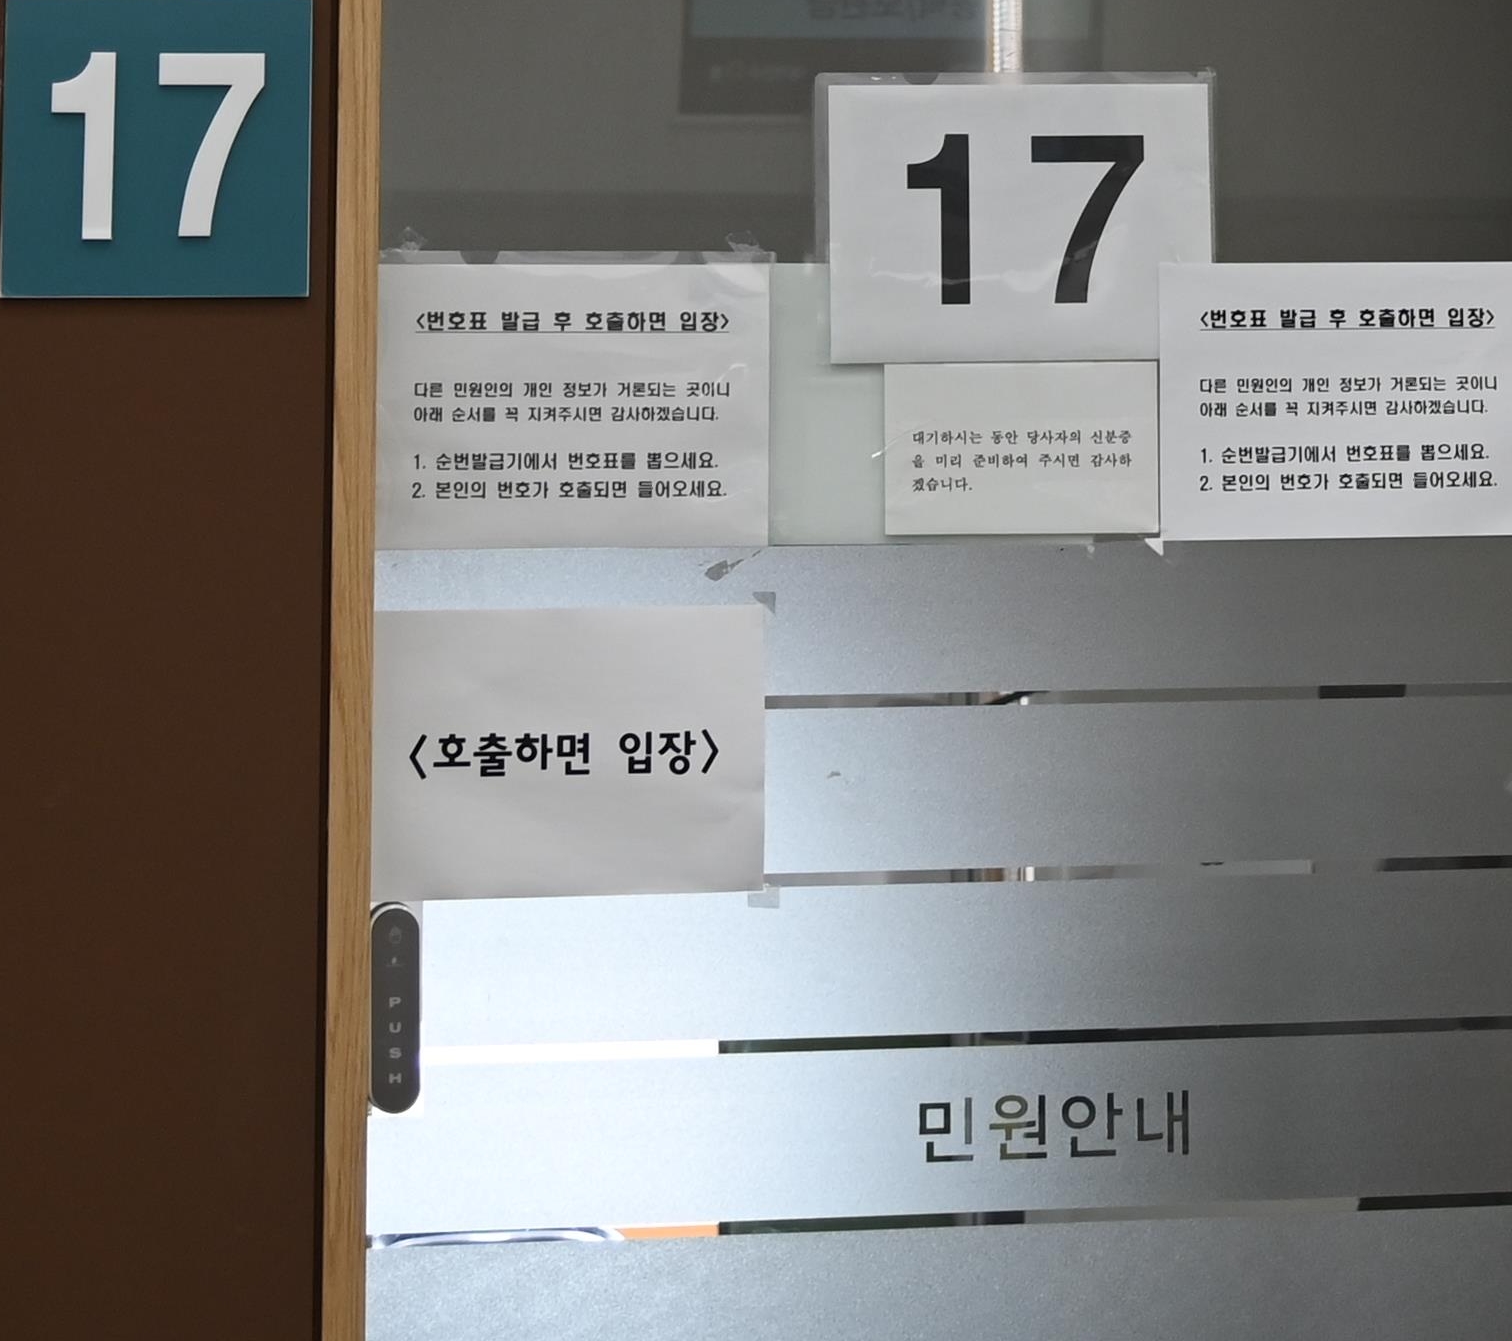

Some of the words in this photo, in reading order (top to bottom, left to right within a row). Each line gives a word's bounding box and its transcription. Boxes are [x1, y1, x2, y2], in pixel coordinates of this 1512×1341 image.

[51, 52, 265, 240] 17
[906, 134, 1144, 305] 17
[416, 311, 487, 331] <번호표
[501, 311, 540, 331] 발급
[553, 311, 572, 331] 후
[585, 311, 666, 331] 호출하면
[680, 311, 729, 331] 입장>
[1200, 309, 1266, 328] <번호표
[1280, 309, 1316, 328] 발급
[1328, 309, 1346, 328] 후
[1359, 308, 1435, 328] 호출하면
[1448, 307, 1495, 327] 입장>
[414, 382, 443, 398] 다른
[454, 382, 513, 398] 민원인의
[524, 382, 552, 397] 개인
[563, 382, 607, 397] 정보가
[617, 382, 675, 397] 거론되는
[687, 382, 730, 397] 곳이니
[1200, 379, 1227, 393] 다른
[1236, 378, 1292, 392] 민원인의
[1302, 378, 1329, 392] 개인
[1339, 377, 1381, 392] 정보가
[1390, 377, 1446, 391] 거론되는
[1456, 376, 1498, 391] 곳이니
[414, 407, 442, 422] 아래
[452, 407, 495, 422] 순서를
[505, 407, 518, 422] 꼭
[528, 406, 602, 422] 지켜주시면
[611, 406, 719, 422] 감사하겠습니다.
[1200, 402, 1227, 417] 아래
[1236, 402, 1277, 417] 순서를
[1285, 402, 1299, 416] 꼭
[1307, 401, 1377, 416] 지켜주시면
[1385, 400, 1488, 415] 감사하겠습니다.
[913, 431, 982, 445] 대기하시는
[991, 431, 1018, 444] 동안
[1027, 430, 1081, 444] 당사자의
[1091, 430, 1131, 444] 신분증
[436, 453, 557, 470] 순번발급기에서
[568, 452, 635, 469] 번호표를
[647, 452, 718, 469] 뽑으세요.
[936, 454, 961, 468] 미리
[973, 454, 1027, 468] 준비하여
[1039, 454, 1080, 467] 주시면
[1091, 453, 1131, 467] 감사하
[1222, 446, 1336, 464] 순번발급기에서
[1346, 445, 1410, 463] 번호표를
[1420, 444, 1489, 461] 뽑으세요.
[436, 481, 486, 499] 본인의
[498, 481, 548, 498] 번호가
[559, 481, 627, 498] 호출되면
[638, 481, 727, 498] 들어오세요.
[912, 477, 972, 492] 겠습니다.
[1222, 474, 1269, 491] 본인의
[1280, 473, 1328, 490] 번호가
[1338, 472, 1403, 490] 호출되면
[1413, 471, 1498, 489] 들어오세요.
[389, 997, 402, 1084] PUSH
[919, 1090, 1189, 1162] 민원안내
